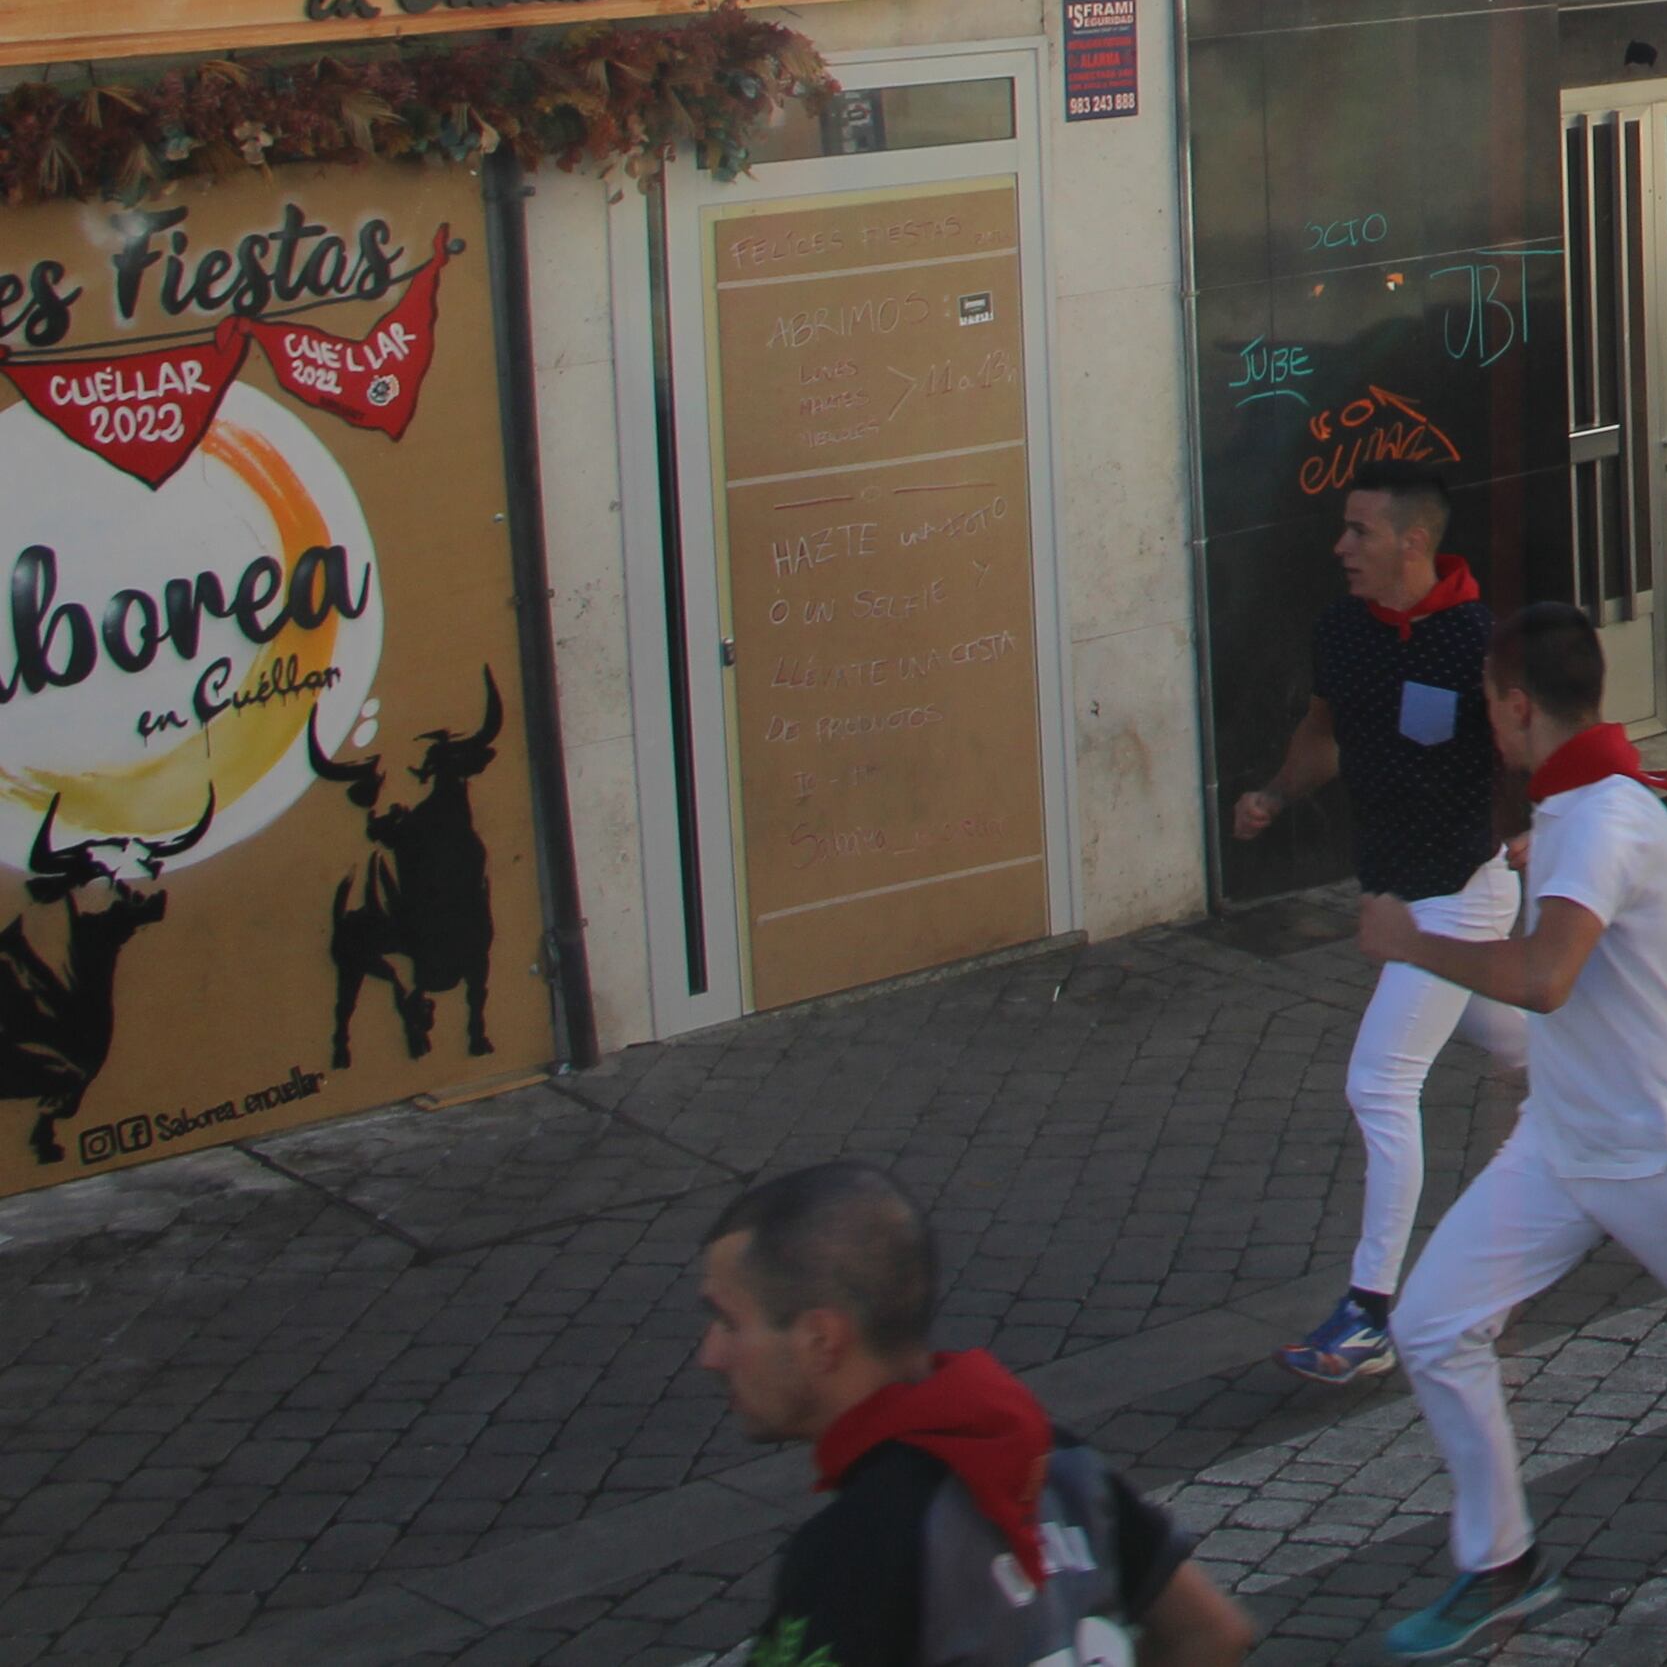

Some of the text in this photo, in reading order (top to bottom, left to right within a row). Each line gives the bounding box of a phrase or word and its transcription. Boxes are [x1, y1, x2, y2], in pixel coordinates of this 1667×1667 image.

[1070, 93, 1135, 114] 983 243 888
[109, 202, 405, 320] Fiestas
[284, 322, 417, 372] CUÉLLAR
[1229, 335, 1314, 387] JUBE
[50, 361, 211, 408] CUÉLLAR
[292, 359, 342, 395] 2022
[89, 402, 186, 444] 2022
[773, 522, 879, 579] HAZTE
[0, 544, 371, 702] borea
[803, 598, 836, 624] UN
[851, 577, 948, 619] SELFIE
[950, 630, 1017, 664] CESTA
[137, 653, 342, 739] en Cuéllar
[764, 714, 802, 743] DE
